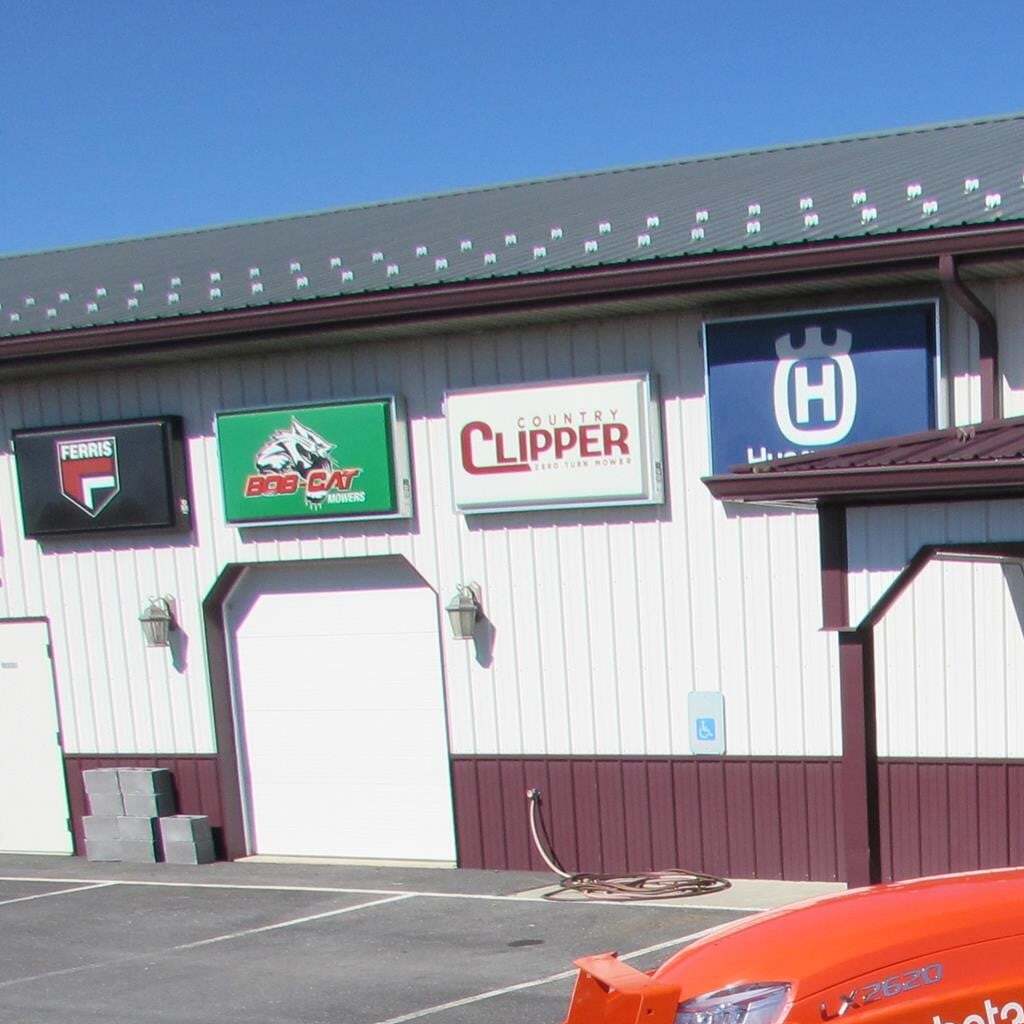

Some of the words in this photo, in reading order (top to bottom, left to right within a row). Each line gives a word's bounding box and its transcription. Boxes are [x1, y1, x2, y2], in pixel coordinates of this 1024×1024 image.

[516, 408, 619, 429] COUNTRY
[61, 440, 114, 461] FERRIS
[460, 420, 630, 476] CLIPPER
[244, 468, 362, 497] BOB-CAT
[327, 491, 366, 504] MOWERS
